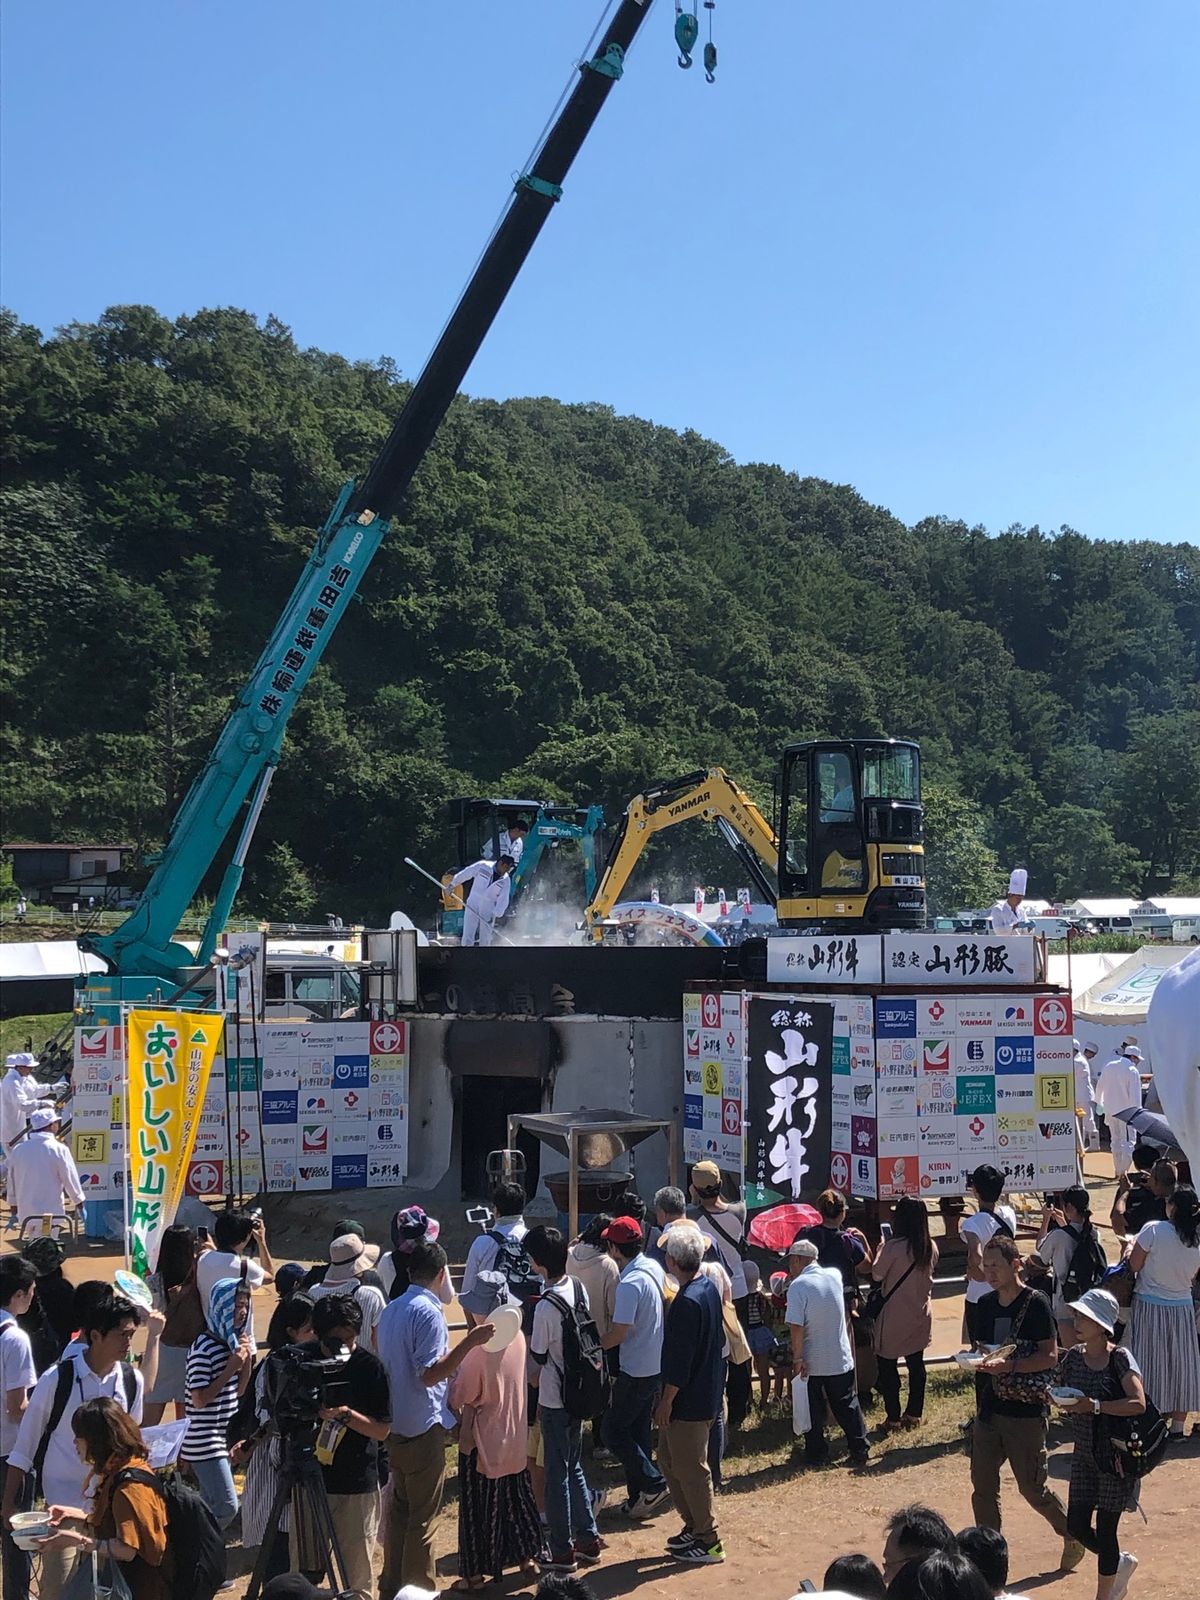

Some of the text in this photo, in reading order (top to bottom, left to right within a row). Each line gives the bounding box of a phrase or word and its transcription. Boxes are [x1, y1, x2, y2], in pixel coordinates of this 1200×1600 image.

[668, 792, 711, 817] YANMAR
[808, 938, 859, 980] 山形牛
[891, 944, 1014, 976] 認定 山形豚
[770, 1009, 814, 1028] 総称
[1036, 1049, 1071, 1059] docomo
[881, 1064, 912, 1076] 小野建設
[959, 1094, 992, 1104] JEFEX
[764, 1029, 819, 1201] 山形牛
[132, 1023, 178, 1231] おいしい山形
[369, 1164, 400, 1177] 山形牛
[928, 1163, 951, 1171] KIRIN
[1003, 1163, 1035, 1180] 山形牛
[932, 1175, 959, 1184] 一番搾り
